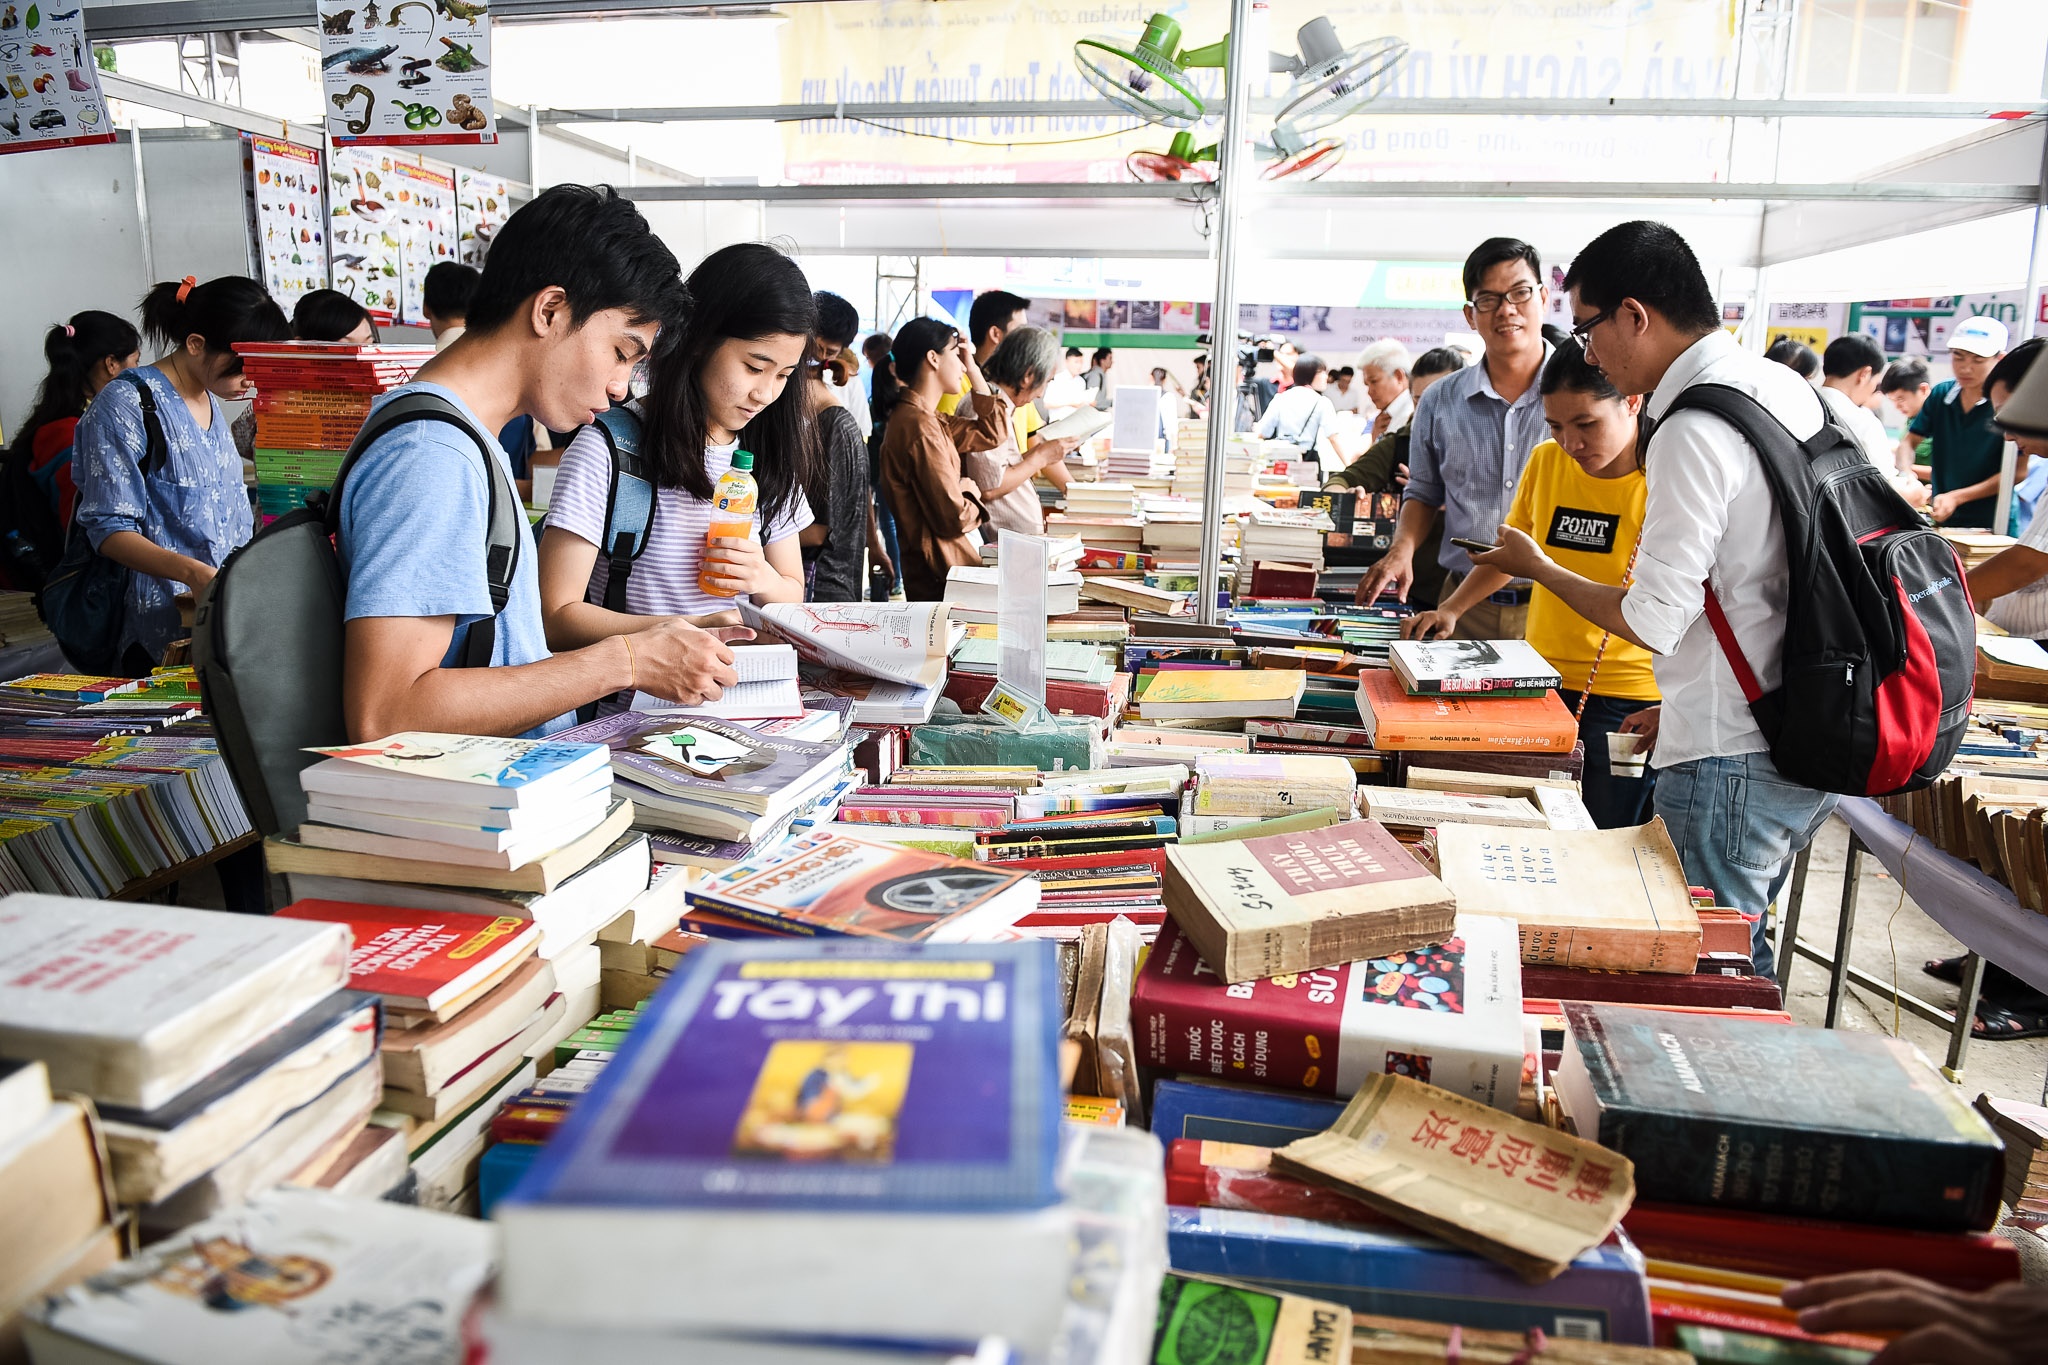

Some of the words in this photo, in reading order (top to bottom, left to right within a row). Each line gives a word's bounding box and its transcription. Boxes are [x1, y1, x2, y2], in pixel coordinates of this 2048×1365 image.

[1557, 515, 1610, 538] POINT
[763, 742, 798, 755] CHỌN
[796, 746, 821, 757] LỌC
[1382, 812, 1406, 820] NGUYỄN
[1286, 841, 1338, 883] THUỐC
[1315, 843, 1363, 880] THỰC
[1337, 838, 1386, 874] HÀNH
[1495, 844, 1518, 882] hành
[1519, 846, 1538, 883] dược
[1539, 847, 1558, 884] khoa
[1526, 930, 1544, 961] dược
[1541, 932, 1560, 962] khoa
[1301, 972, 1338, 1004] SỬ
[1381, 975, 1397, 992] New
[712, 979, 876, 1029] Tây
[883, 980, 1007, 1023] Thi
[1184, 1026, 1203, 1061] THUỐC
[1210, 1020, 1228, 1050] DƯỢC
[1254, 1030, 1271, 1062] DỤNG
[1208, 1052, 1227, 1074] BIỆT
[1249, 1062, 1268, 1077] SỬ
[1657, 1032, 1706, 1094] ALMANACH
[1711, 1134, 1731, 1199] ALMANACH
